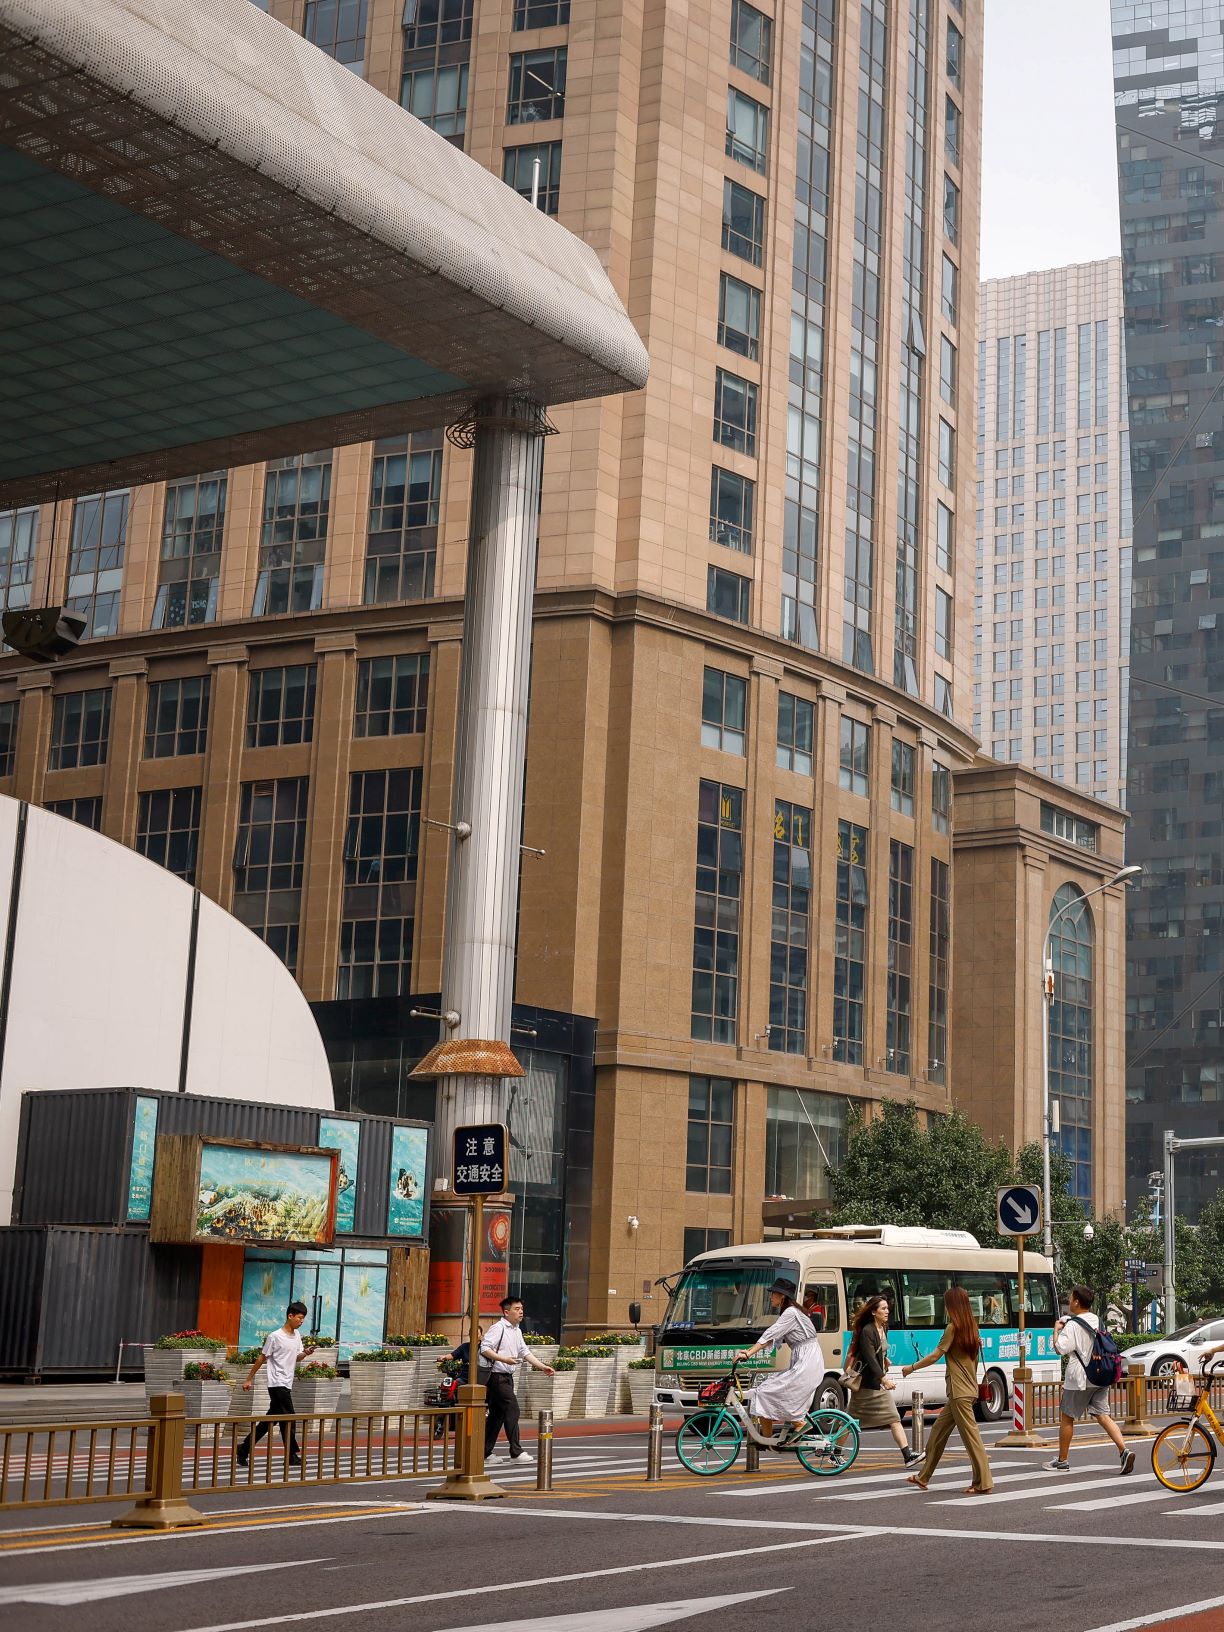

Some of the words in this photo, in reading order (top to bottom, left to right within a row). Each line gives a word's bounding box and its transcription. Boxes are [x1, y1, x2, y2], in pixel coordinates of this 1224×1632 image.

[465, 1136, 495, 1156] 注意
[456, 1163, 503, 1183] 交通安全
